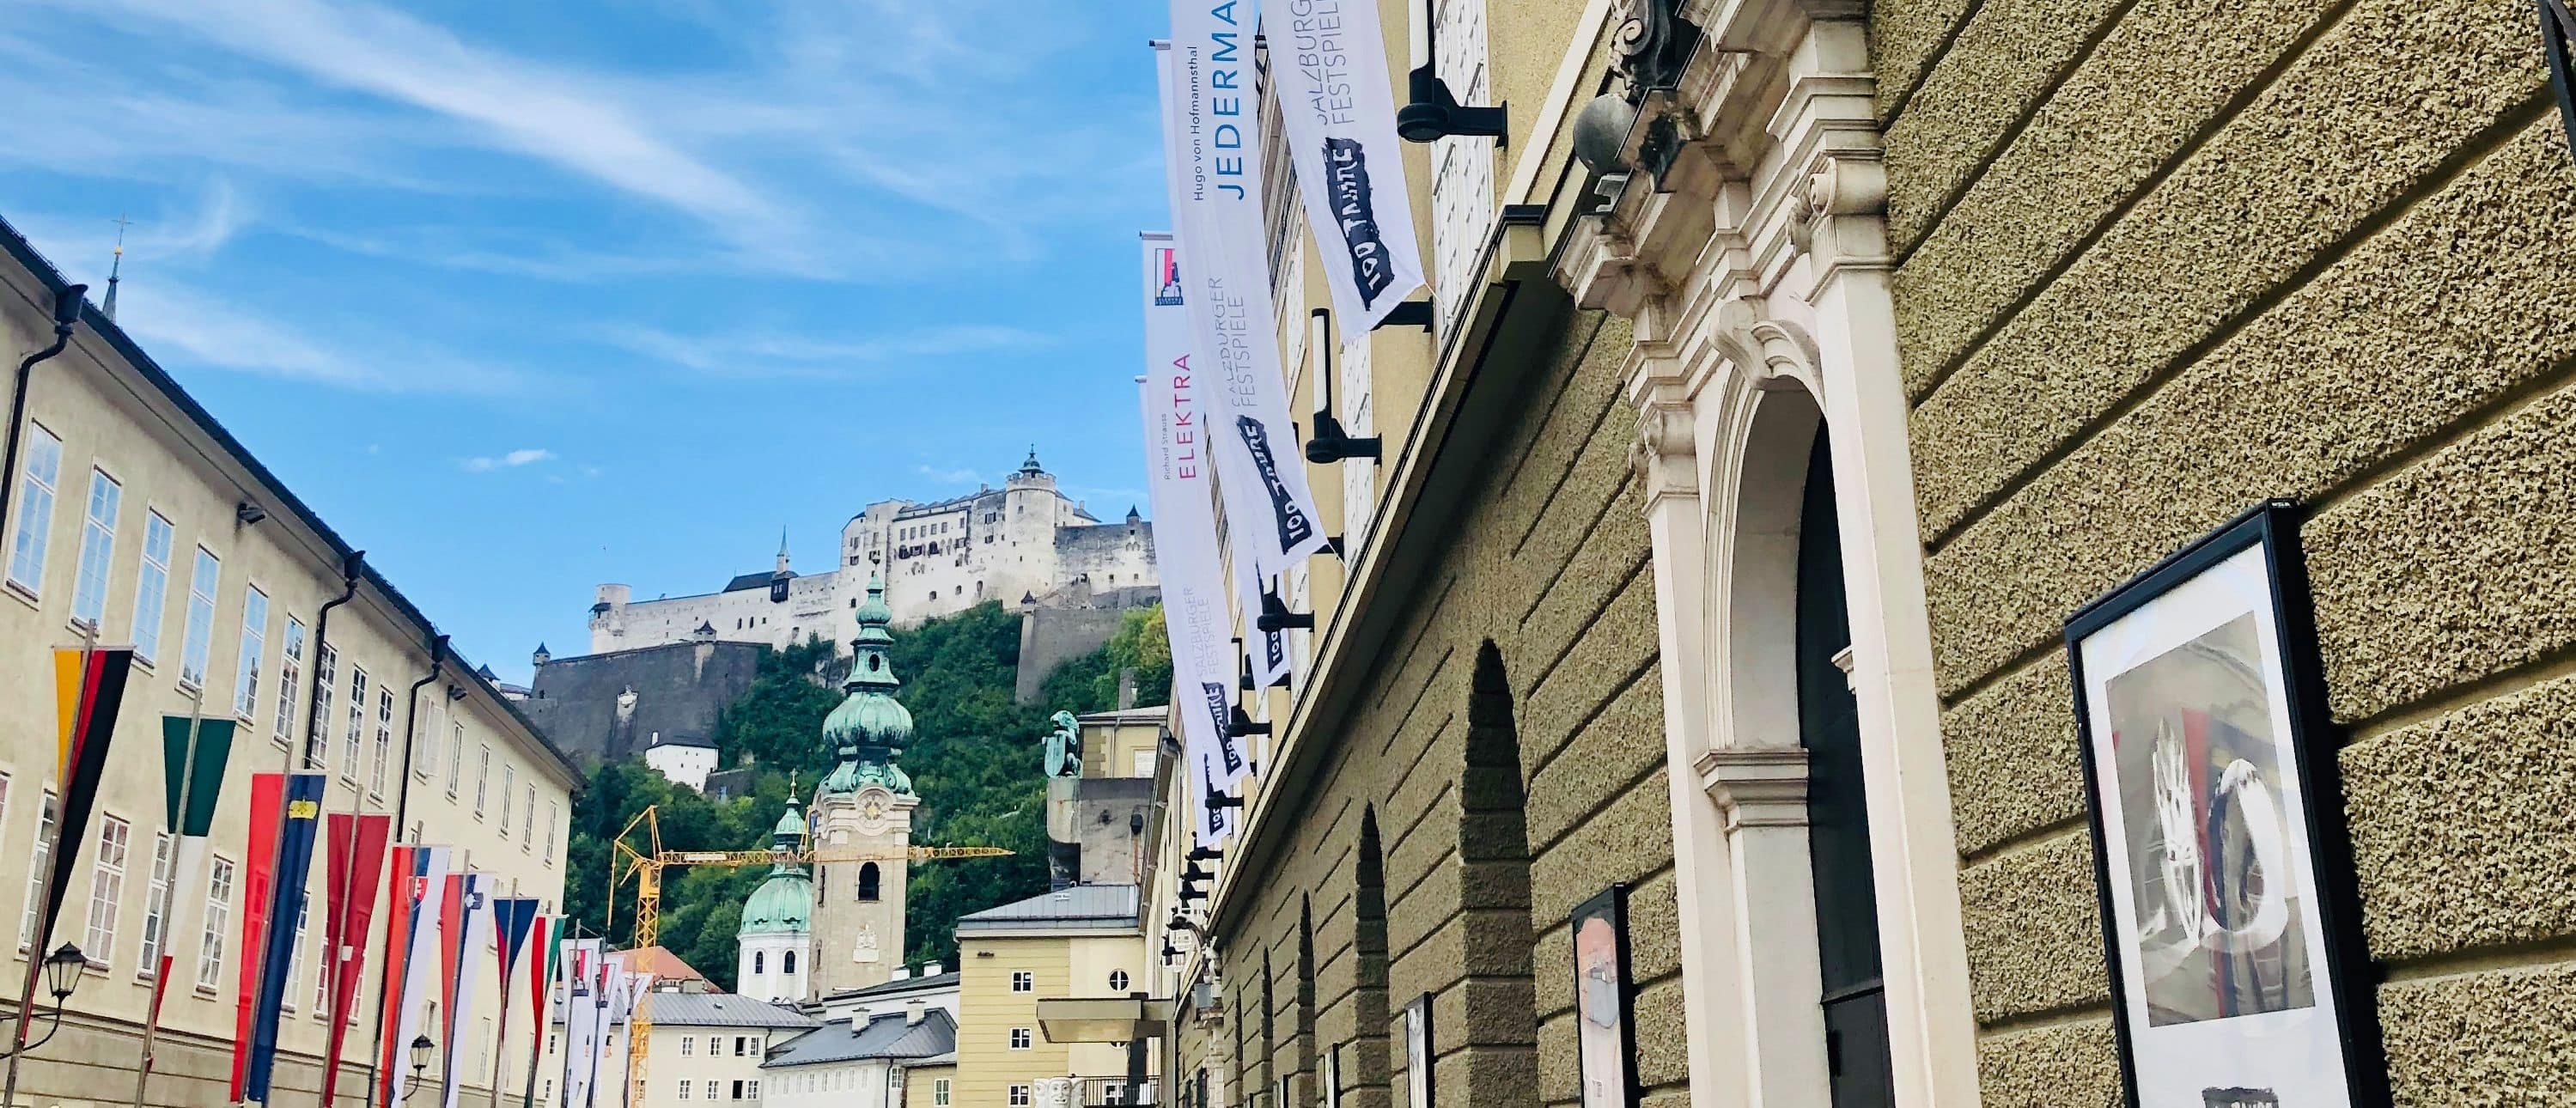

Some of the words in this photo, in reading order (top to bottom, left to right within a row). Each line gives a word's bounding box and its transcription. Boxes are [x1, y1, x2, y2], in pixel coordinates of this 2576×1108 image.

[1187, 46, 1201, 134] Hofmannsthal
[1210, 0, 1245, 200] JEDERMA
[1194, 166, 1205, 202] Hugo
[1354, 241, 1381, 290] 100
[1227, 295, 1258, 407] FESTSPIELE
[1160, 412, 1169, 446] Strauss
[1173, 353, 1197, 479] ELEKTRA
[1161, 447, 1171, 480] Richard
[1284, 500, 1305, 540] 100
[1226, 740, 1239, 767] 100
